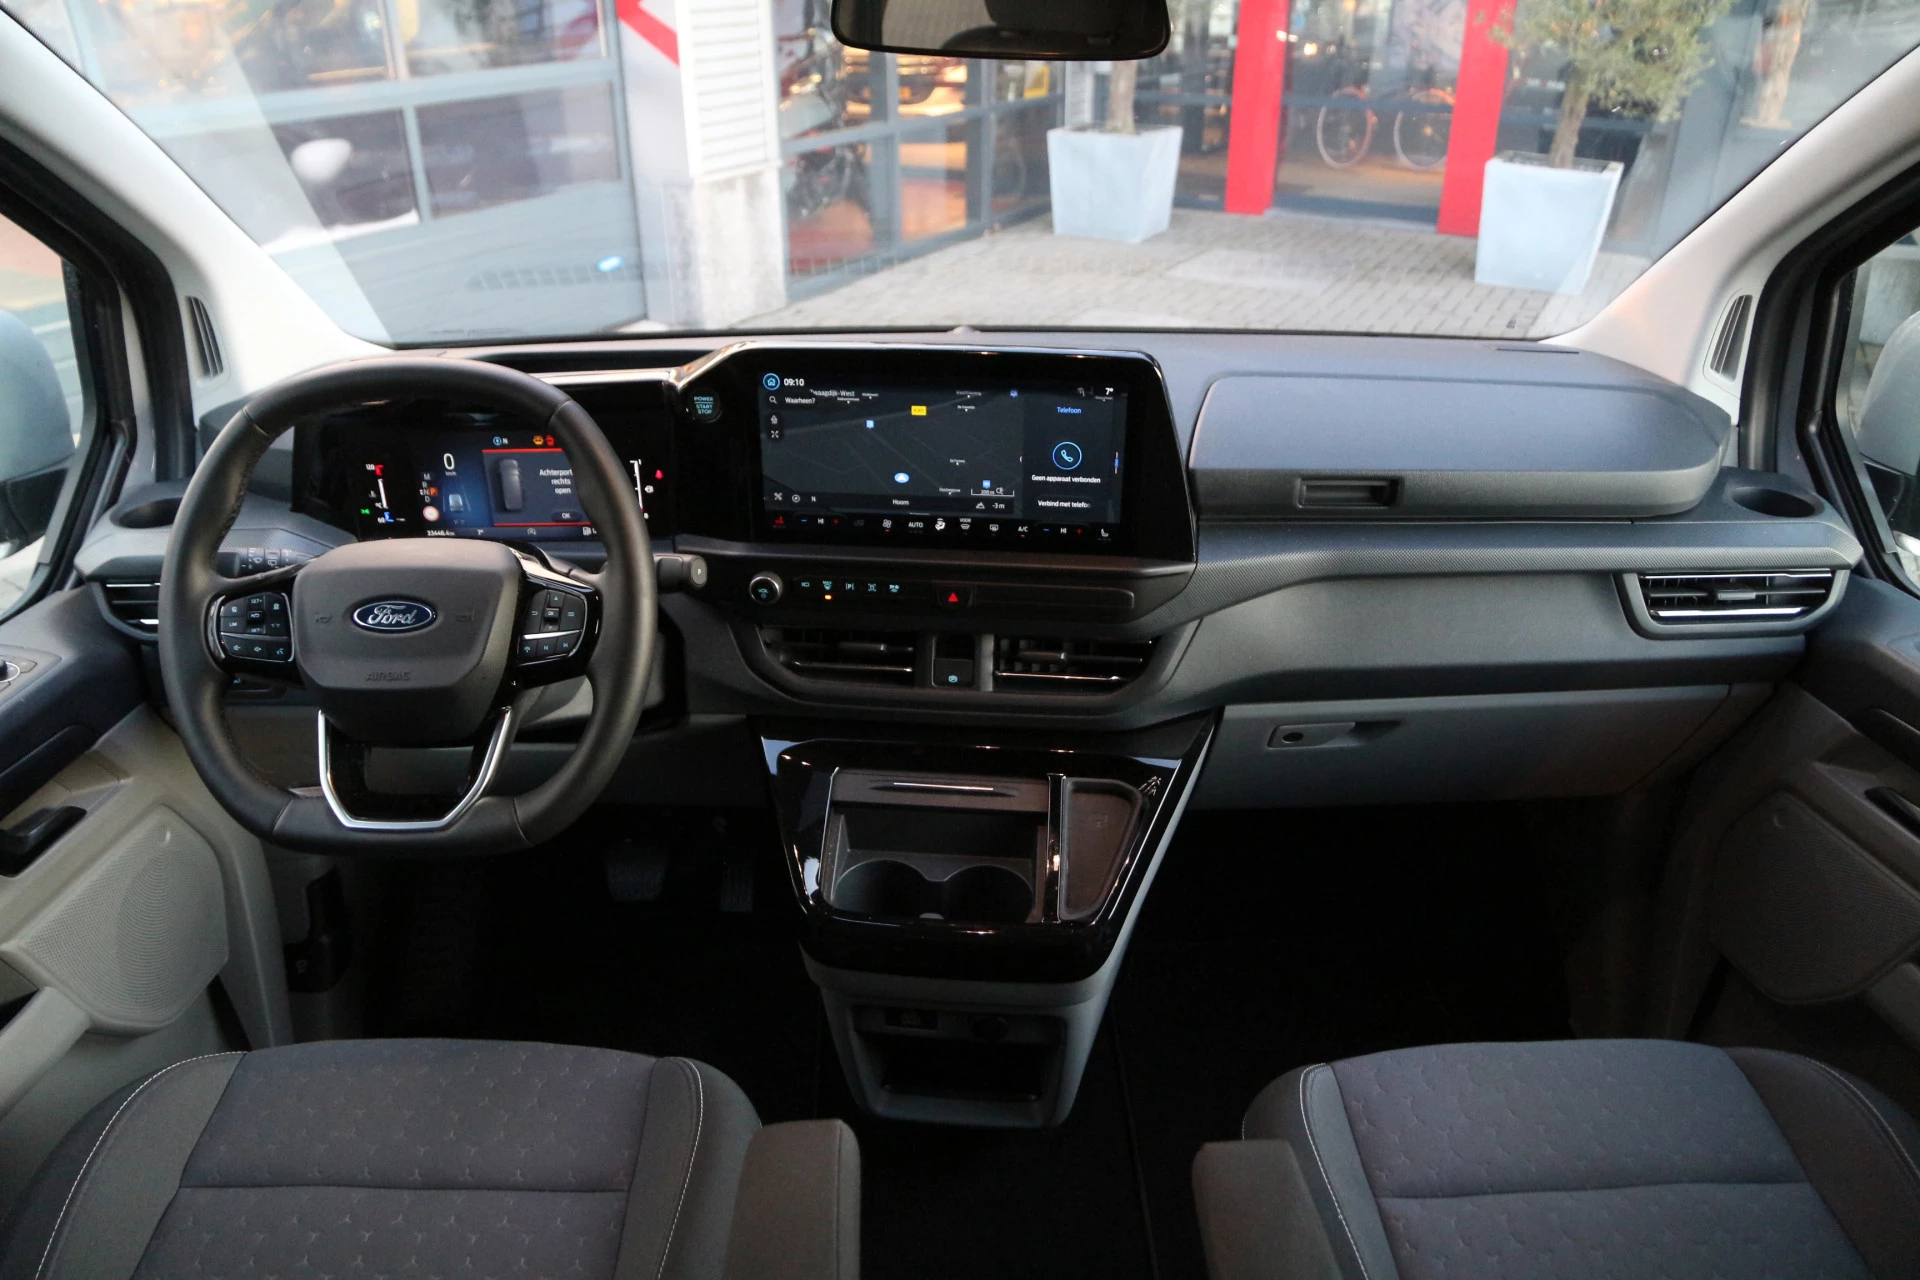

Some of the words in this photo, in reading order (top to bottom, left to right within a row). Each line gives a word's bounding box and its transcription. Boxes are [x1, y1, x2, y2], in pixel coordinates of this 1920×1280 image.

[783, 378, 805, 387] 09:10
[810, 388, 855, 398] waagdijk-West
[1056, 406, 1082, 414] Telefoon
[443, 452, 455, 470] 0
[551, 477, 571, 485] rechts
[1031, 474, 1046, 482] Geen
[1046, 475, 1071, 483] apparaat
[1072, 475, 1101, 483] verbonden
[554, 487, 571, 495] open
[1037, 499, 1059, 507] Verbind
[1017, 525, 1029, 533] A/C
[367, 604, 418, 625] Ford
[366, 671, 411, 682] AIRBAG
